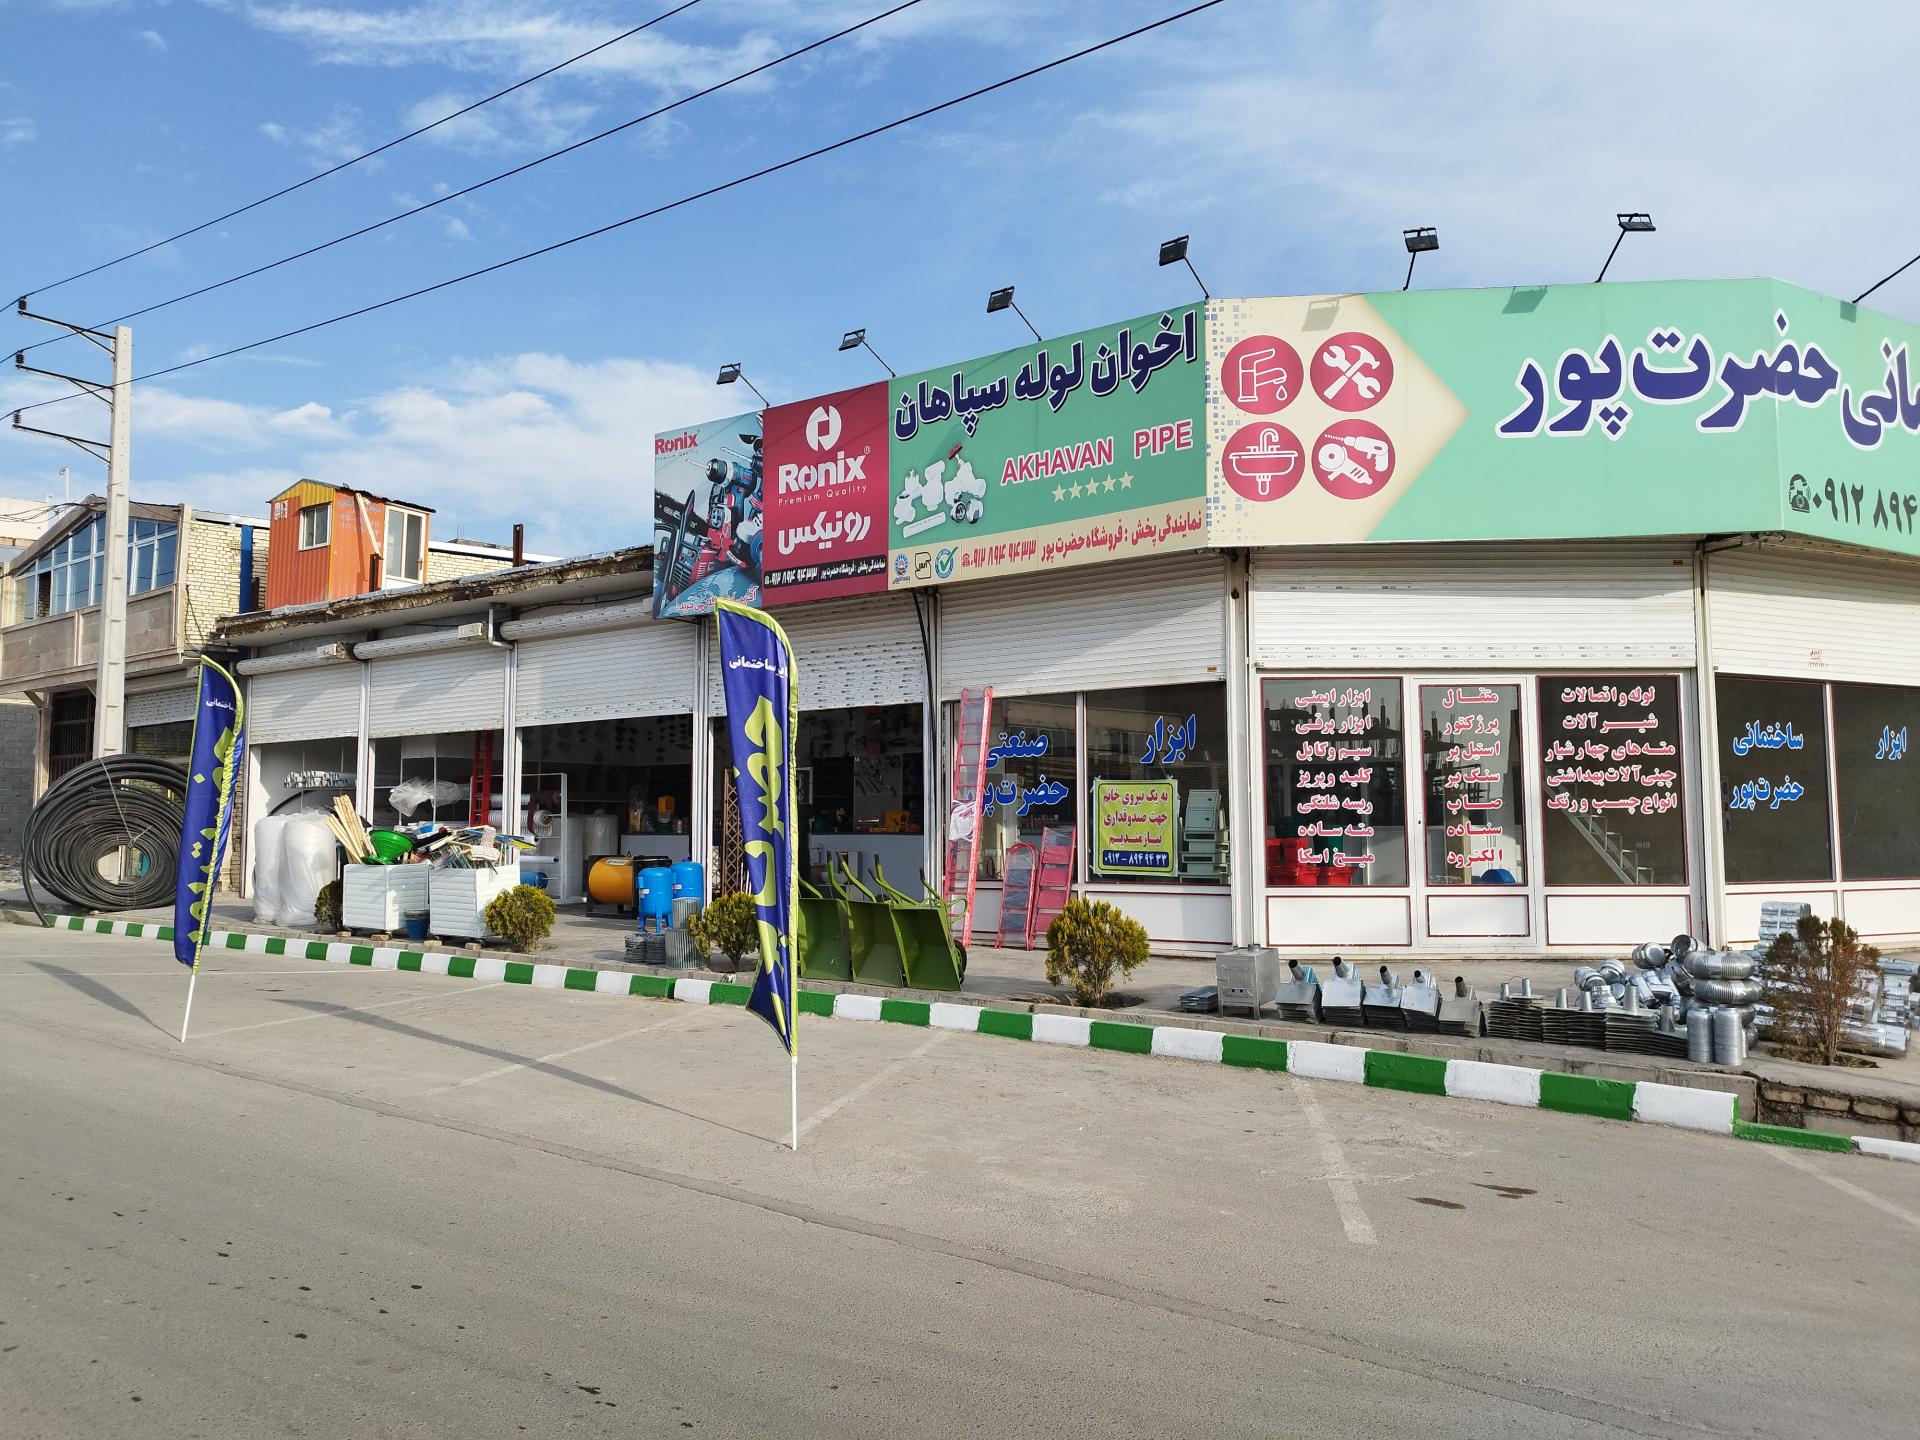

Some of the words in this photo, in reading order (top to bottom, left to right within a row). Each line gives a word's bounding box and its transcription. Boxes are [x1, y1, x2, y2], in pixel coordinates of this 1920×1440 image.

[1090, 311, 1196, 395] اخوان
[1014, 341, 1084, 411] لوله
[1630, 311, 1840, 429] حضرت
[1496, 336, 1631, 440] پور
[894, 372, 1008, 440] سپاهان
[655, 431, 698, 455] Ronix
[1001, 436, 1113, 486] AKHAVAN
[1133, 420, 1192, 459] PIPE
[779, 493, 820, 507] Premium
[826, 484, 867, 498] Quality
[1813, 478, 1863, 525] ۰۹۱۲
[779, 511, 871, 555] رونیکس
[1085, 518, 1123, 552] فروشگاه
[1131, 516, 1156, 547] پخش
[1159, 510, 1202, 543] نمایندگی
[1041, 542, 1055, 564] پور
[1056, 532, 1085, 559] حضرت
[729, 655, 776, 671] ساختمانی
[1295, 688, 1336, 708] ایمنی
[1338, 688, 1371, 707] ابزار
[1561, 686, 1618, 702] اتصالات
[1629, 686, 1655, 706] لوله
[1295, 712, 1335, 734] برقی
[1338, 714, 1372, 734] ابزار
[1563, 712, 1598, 729] آلات
[1600, 712, 1658, 733] شیر
[1140, 714, 1196, 764] ابزار
[1642, 741, 1676, 755] مته
[1733, 720, 1804, 756] ساختمانی
[1875, 725, 1907, 760] ابزار
[986, 731, 1048, 769] صنعتی
[1296, 741, 1328, 761] کابل
[1338, 747, 1372, 760] سیم
[1446, 745, 1460, 761] بر
[1462, 741, 1500, 760] استیل
[1545, 740, 1575, 761] شیار
[1575, 740, 1609, 761] چهار
[1611, 740, 1641, 760] های
[1297, 770, 1327, 789] پریز
[1340, 767, 1373, 787] کلید
[1445, 772, 1461, 788] بر
[1547, 766, 1605, 787] بهداشتی
[1605, 765, 1641, 782] آلات
[1641, 768, 1677, 788] چینی
[995, 774, 1069, 816] حضرت
[1122, 787, 1145, 806] نیروی
[1147, 788, 1158, 805] یک
[1547, 792, 1578, 812] رنگ
[1730, 780, 1756, 811] پور
[1755, 775, 1804, 810] حضرت
[1297, 794, 1340, 814] شلنگی
[1342, 797, 1373, 814] ریسه
[1579, 798, 1589, 812] و
[1592, 796, 1640, 815] چسب
[1641, 792, 1678, 814] انواع
[1103, 808, 1146, 827] صندوقداری
[1149, 811, 1168, 827] جهت
[1298, 820, 1343, 836] ساده
[1344, 822, 1374, 836] مته
[1447, 821, 1503, 842] سنباده
[1109, 830, 1162, 848] نیازمندیم
[1298, 848, 1329, 863] اسکا
[1333, 847, 1375, 868] میخ
[1447, 848, 1503, 868] الکترود
